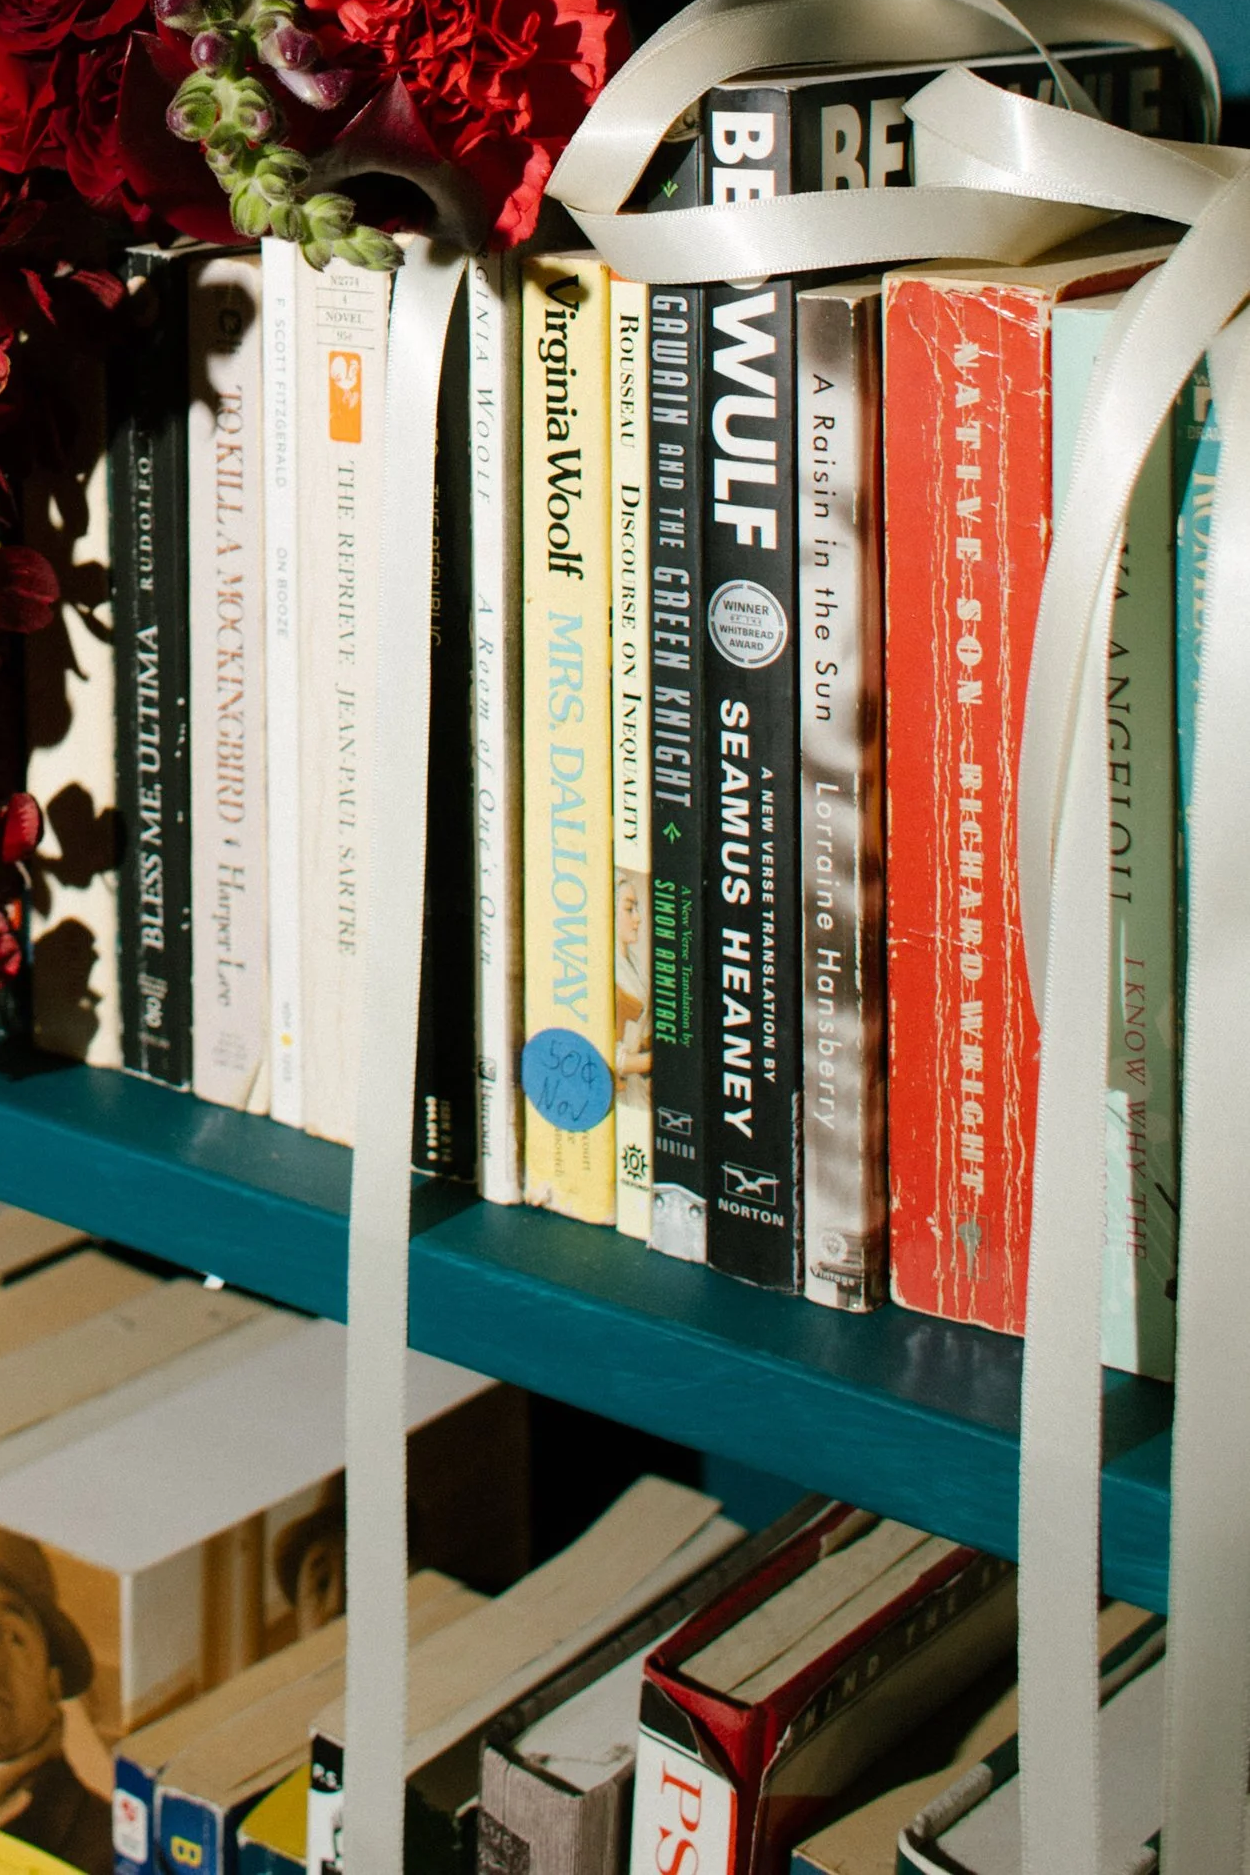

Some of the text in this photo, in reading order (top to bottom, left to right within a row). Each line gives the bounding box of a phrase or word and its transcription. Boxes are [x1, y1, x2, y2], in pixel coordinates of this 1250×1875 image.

[275, 318, 288, 373] SCOTT
[619, 312, 641, 448] ROUSSEAU
[711, 110, 782, 551] BEWULF
[274, 380, 288, 488] FITZGERALD
[475, 387, 496, 504] WOOLF
[537, 274, 585, 581] Virginia Woolf
[137, 456, 154, 592] RUDOLFO
[216, 385, 246, 824] TO KILL A MOCKINGBIRD
[275, 546, 289, 639] ON BOOZE
[337, 459, 356, 665] THE REPRIEVE
[476, 594, 494, 615] A
[652, 294, 692, 809] GAWAIN AND THE GREEN KNIGHT
[811, 372, 840, 723] A Raisin in the Sun
[953, 342, 984, 706] NATIVE SON
[477, 638, 497, 721] Room
[620, 483, 643, 845] DISCOURSE ON INEQUALITY
[718, 623, 775, 641] WHITBREAD
[722, 599, 771, 617] WINNER
[728, 637, 765, 653] AWARD
[136, 625, 165, 949] BLESS ME, ULTIMA
[336, 682, 356, 956] JEAN-PAUL SARTRE
[474, 740, 495, 773] of
[547, 610, 588, 1023] MRS. DALLOWAY
[211, 863, 246, 1007] Harper Lee
[477, 895, 498, 968] Own
[654, 878, 678, 1046] SIMON ARMITAGE
[678, 885, 694, 1050] A New Verse Translation by
[719, 698, 754, 1140] SEAMUS HEANEY
[760, 766, 777, 1084] A NEW VERSE TRANSLATION BY
[813, 780, 843, 1132] Lorraine Hansberry
[958, 762, 985, 1197] RICHARD WRIGHT
[655, 1136, 696, 1162] NORTON
[1123, 955, 1149, 1261] I KNOW WHY THE
[716, 1197, 785, 1228] NORTON
